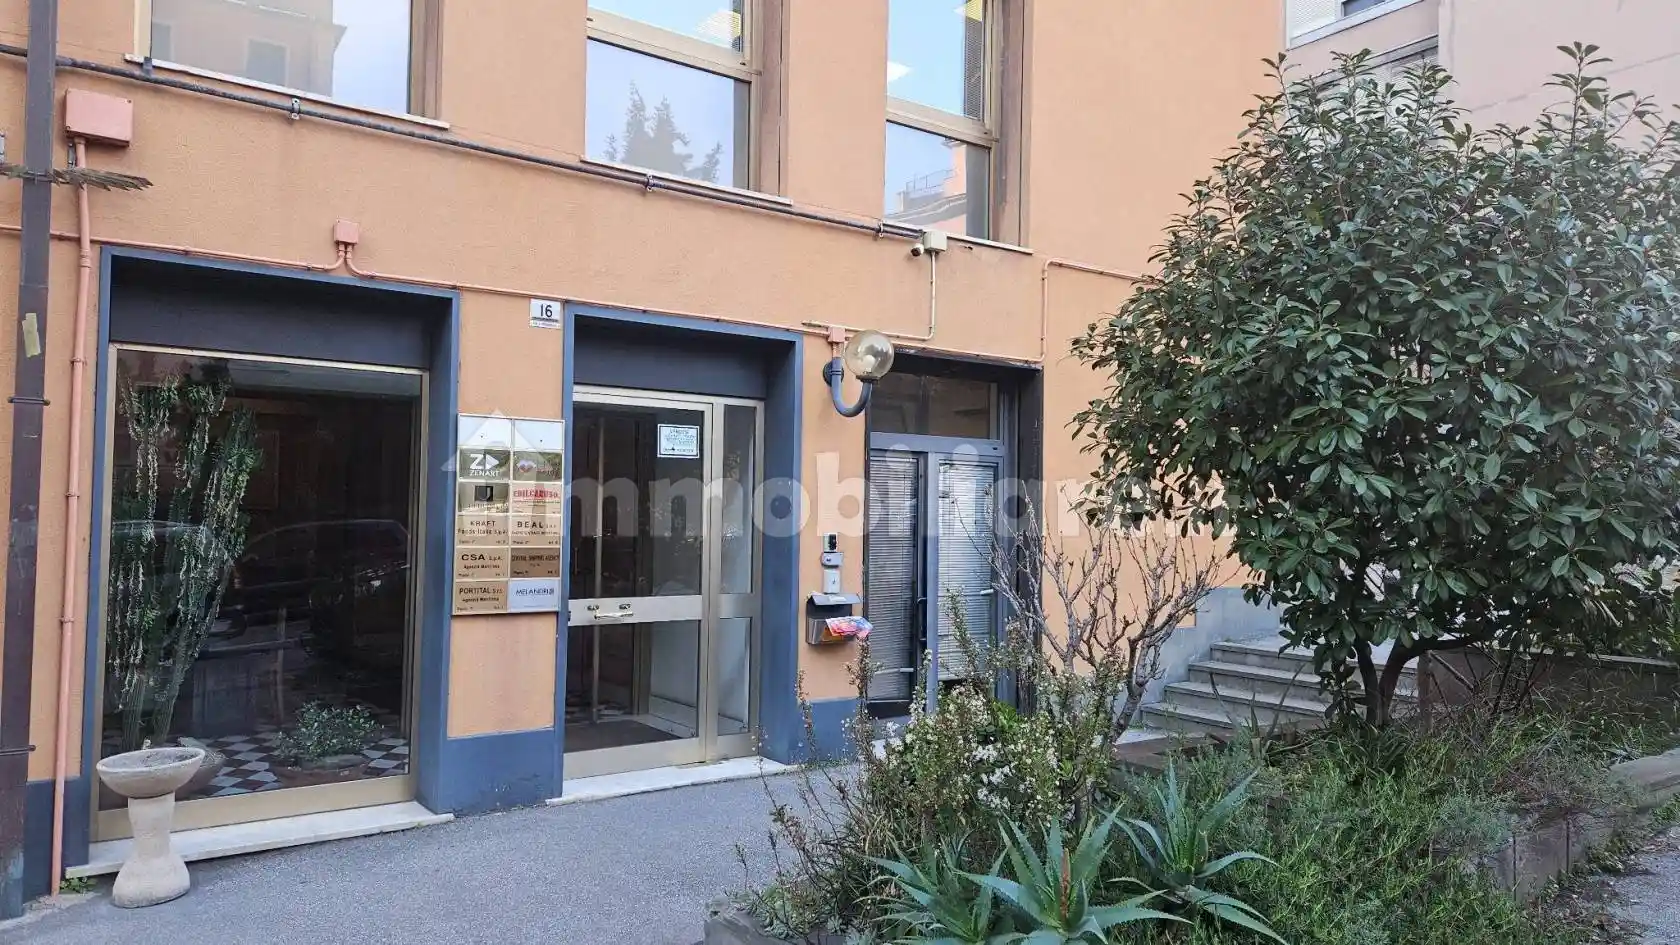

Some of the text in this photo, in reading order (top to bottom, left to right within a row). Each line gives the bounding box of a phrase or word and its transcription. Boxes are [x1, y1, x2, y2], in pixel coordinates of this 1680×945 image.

[540, 303, 553, 318] 16
[517, 521, 544, 529] BEAL
[461, 553, 486, 561] CSA
